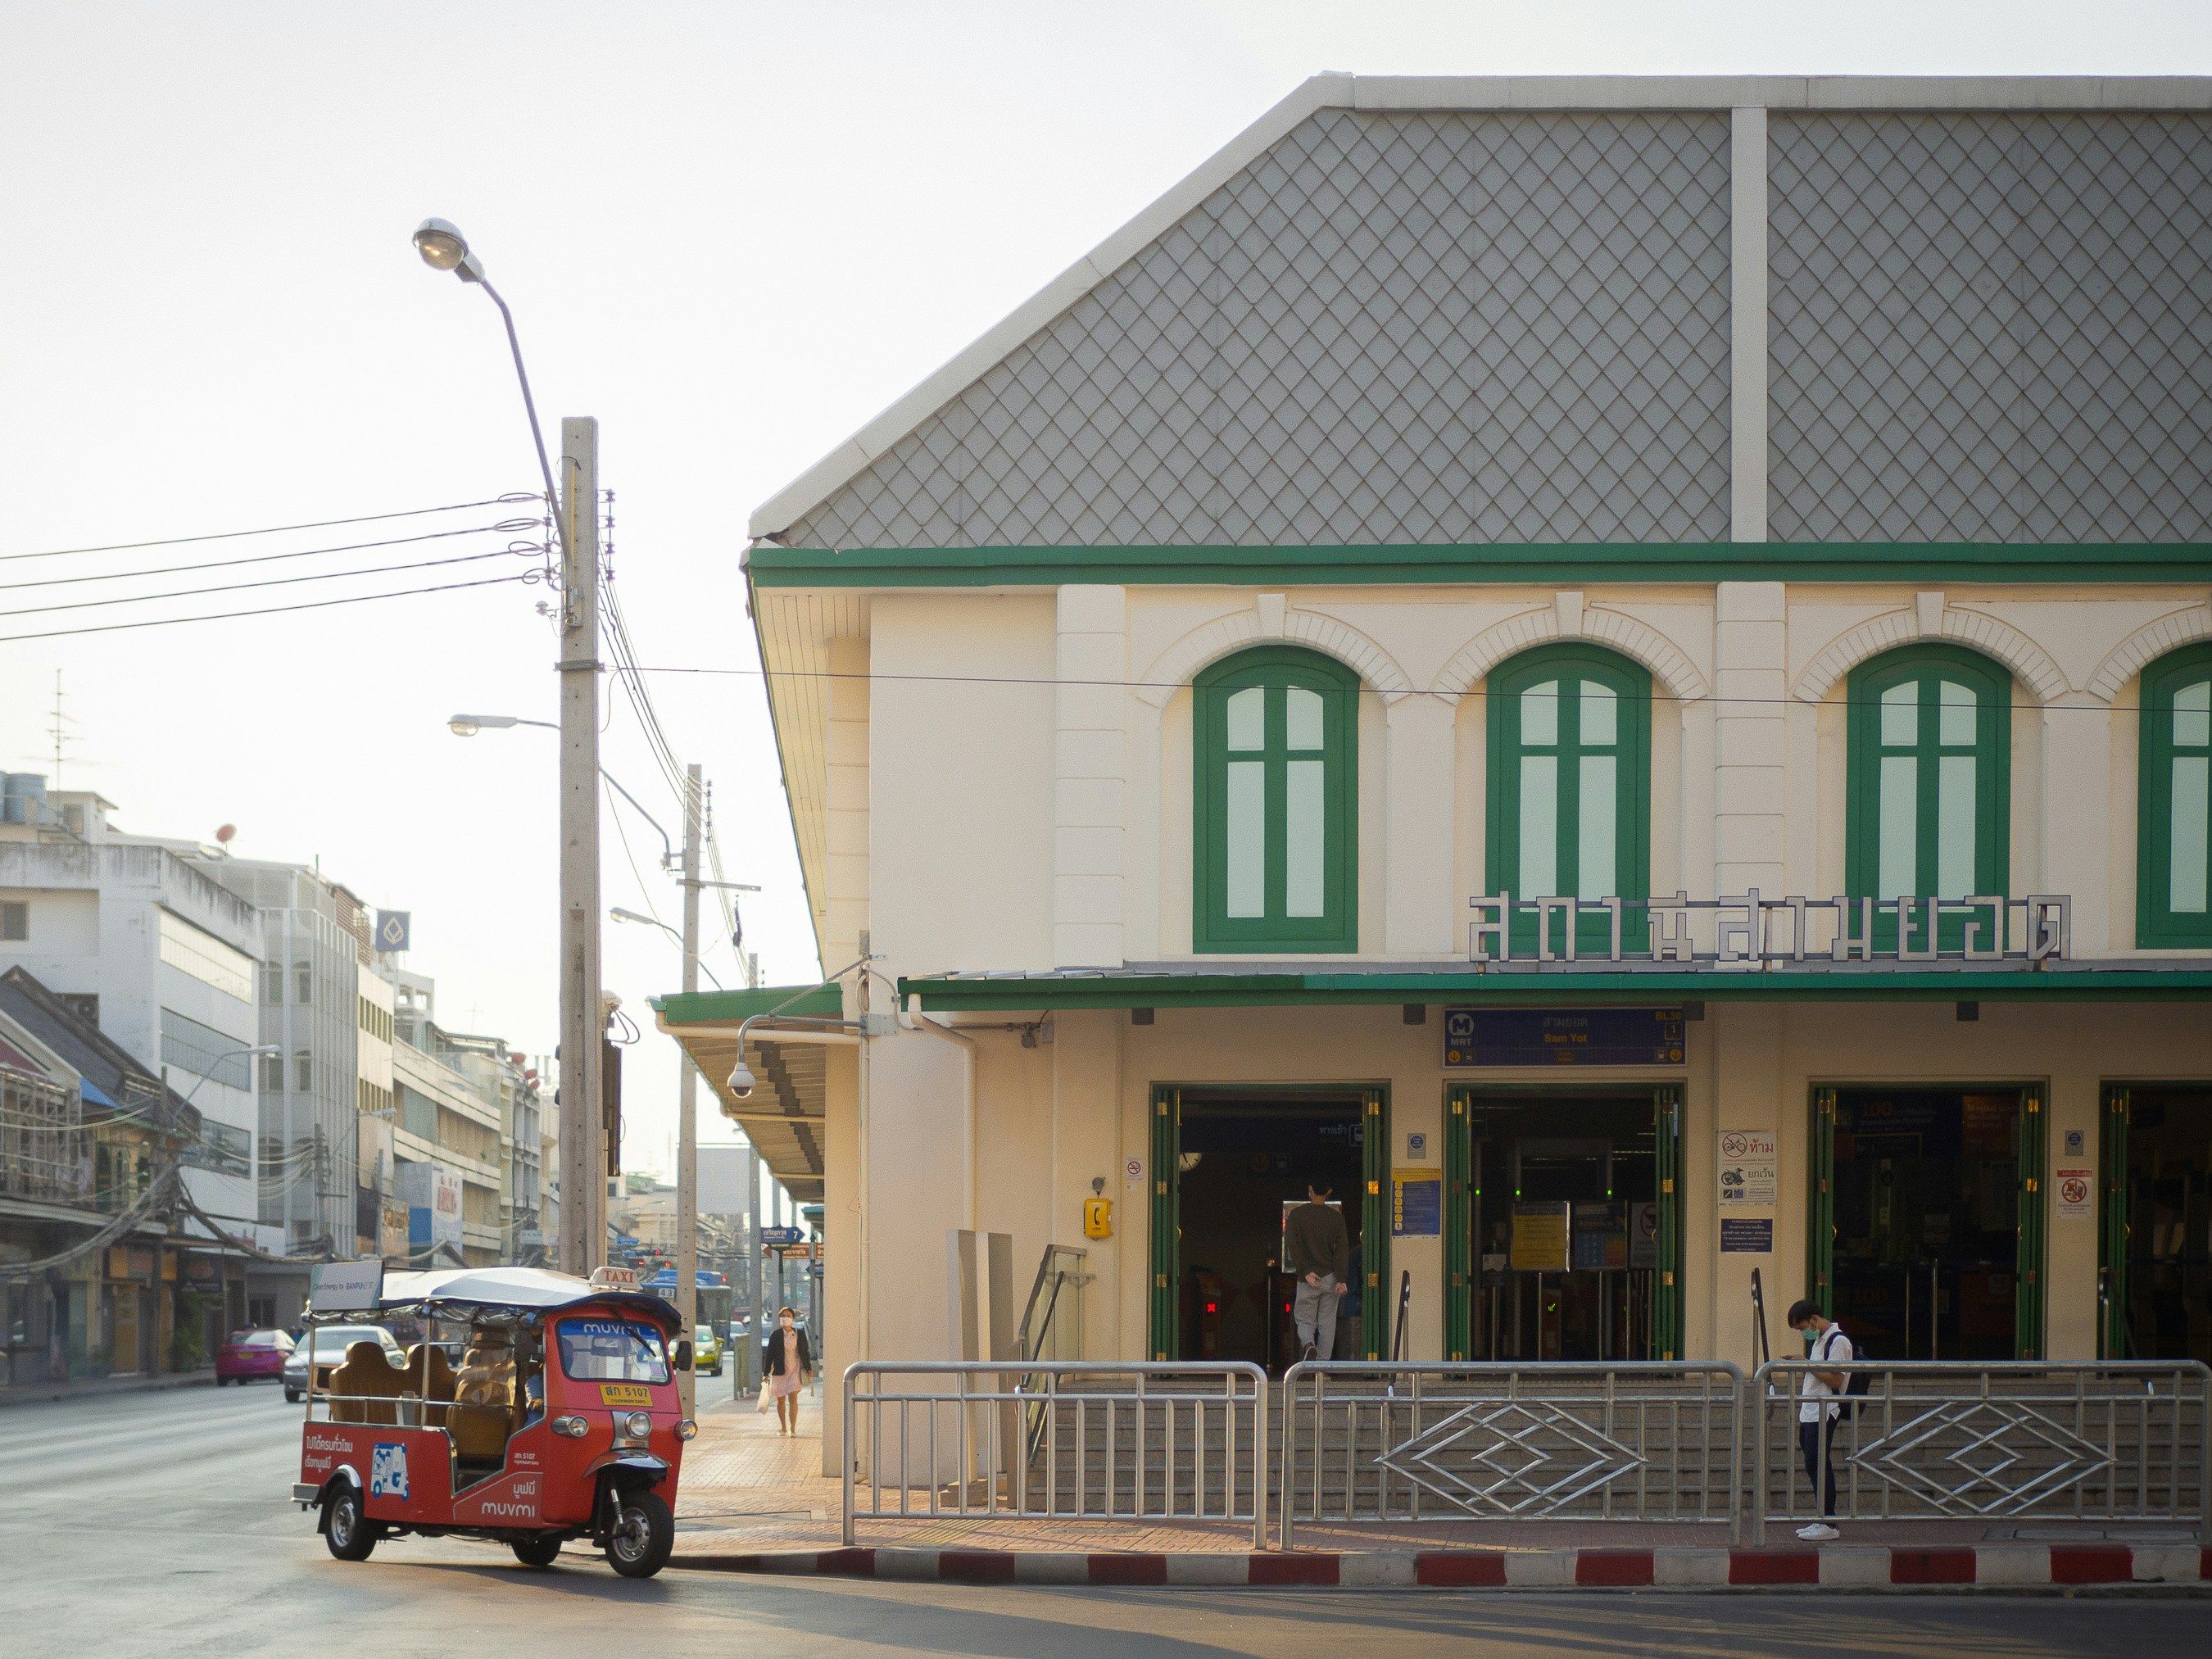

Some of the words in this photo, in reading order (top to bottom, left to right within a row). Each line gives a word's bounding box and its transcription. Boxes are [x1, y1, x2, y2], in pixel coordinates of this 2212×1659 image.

[1469, 887, 2071, 962] สถานีสามยอด
[1655, 1011, 1682, 1021] BL30
[1542, 1017, 1588, 1027] สามยอด
[1450, 1037, 1472, 1045] MRT
[1543, 1034, 1567, 1043] Sam
[1571, 1033, 1588, 1043] Yot
[1749, 1139, 1774, 1154] ห้าม
[1747, 1167, 1775, 1179] ยกเว้น
[604, 1270, 635, 1283] TAXI
[660, 1289, 673, 1297] 43
[605, 1386, 621, 1396] สก
[625, 1387, 648, 1397] 5107
[513, 1480, 536, 1499] มูฟมี
[481, 1502, 535, 1517] muvmi
